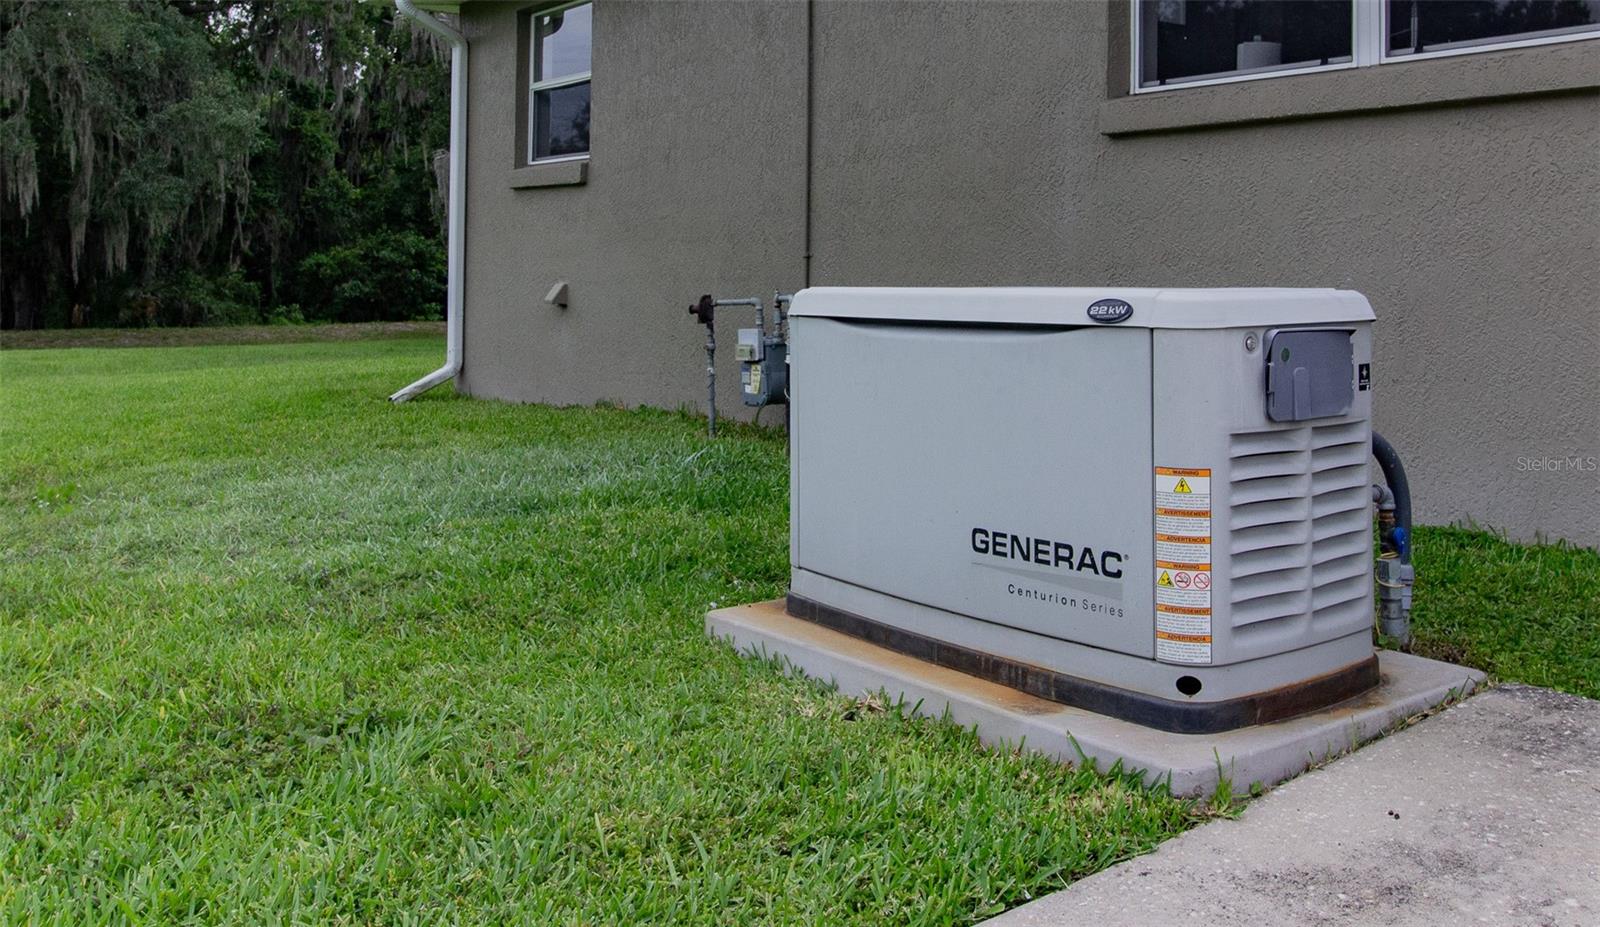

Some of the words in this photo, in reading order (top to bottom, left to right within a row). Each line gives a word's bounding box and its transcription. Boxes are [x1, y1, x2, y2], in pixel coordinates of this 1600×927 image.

[1090, 305, 1107, 315] 22
[1108, 305, 1128, 315] kW
[971, 527, 1123, 579] GENERAC
[1008, 583, 1077, 608] Centurion
[1082, 599, 1124, 618] Series
